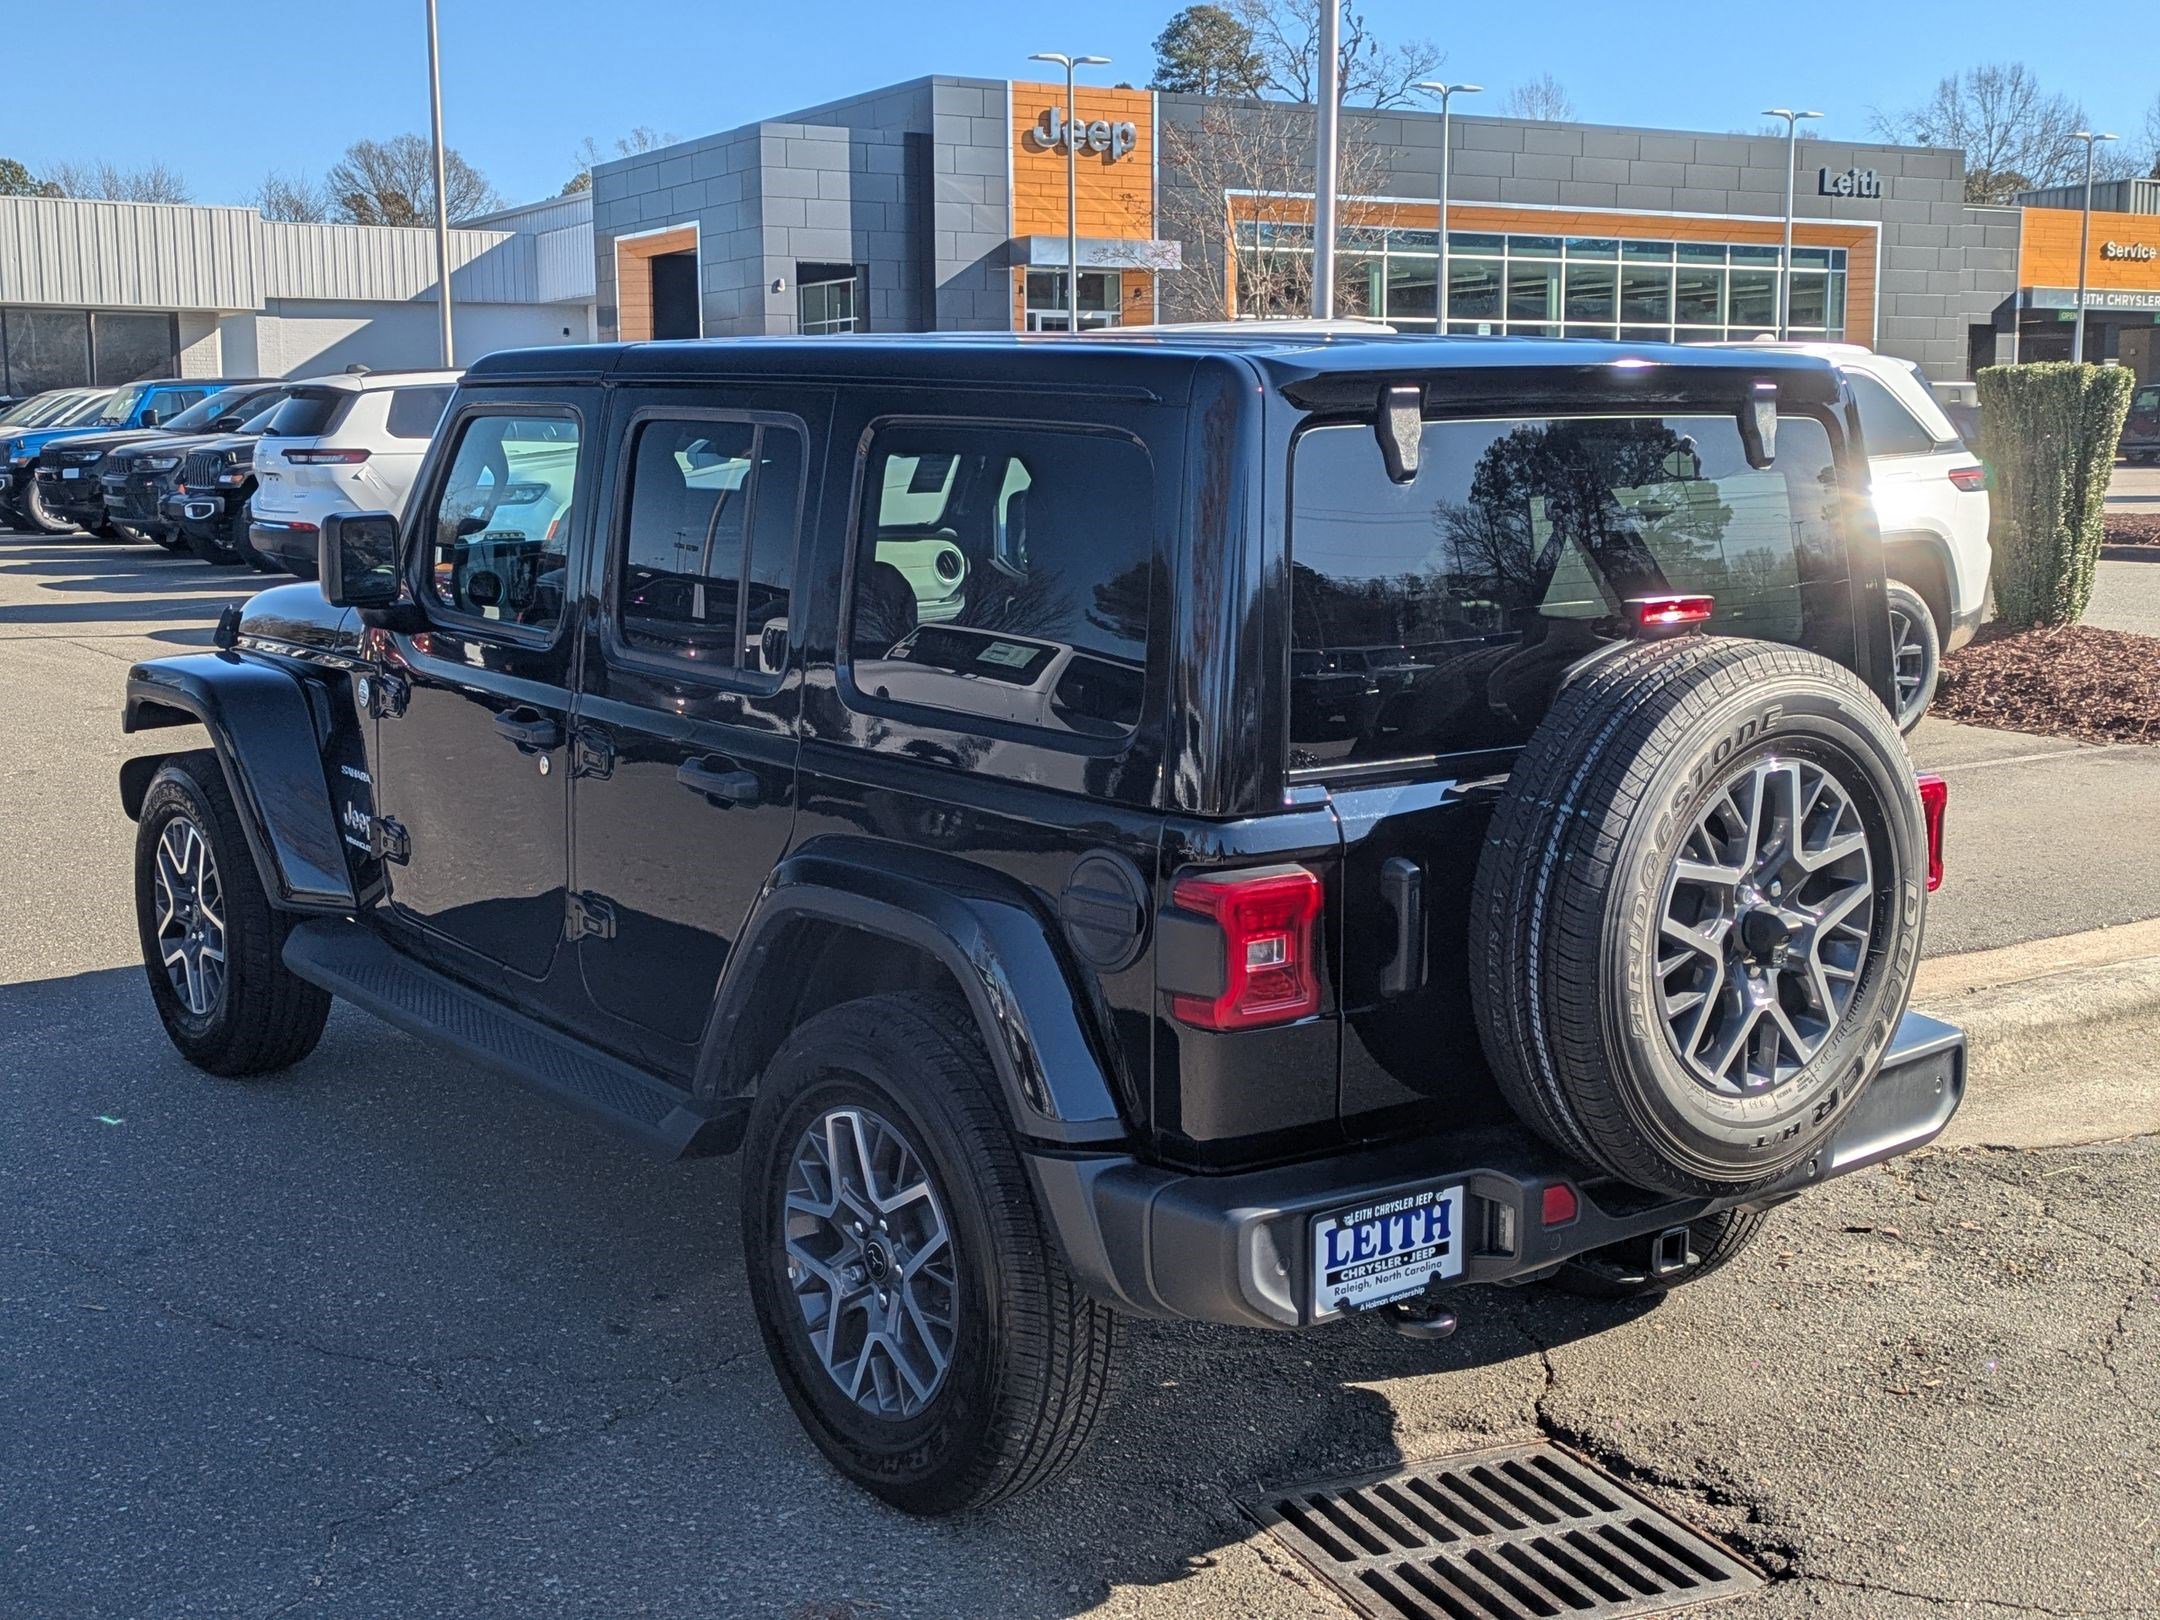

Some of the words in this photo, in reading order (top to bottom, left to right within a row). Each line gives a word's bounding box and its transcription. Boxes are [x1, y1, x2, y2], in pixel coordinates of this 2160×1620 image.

[1033, 106, 1137, 161] Jeep
[1822, 166, 1884, 197] Leith
[2106, 240, 2157, 259] Service
[2073, 293, 2104, 306] LEITH
[2107, 294, 2160, 308] CHRYSLER
[1624, 703, 1784, 1042] BRIDGESTONE
[1811, 878, 1921, 1128] DUELER
[1748, 1120, 1801, 1152] H/T
[1350, 1208, 1373, 1224] LEITH
[1374, 1197, 1415, 1218] CHRYSLER
[1415, 1191, 1434, 1206] JEEP
[1324, 1198, 1452, 1270] LEITH
[1334, 1279, 1372, 1297] Raleigh,
[1375, 1269, 1402, 1286] North
[1405, 1261, 1443, 1277] Carolina
[1340, 1256, 1402, 1281] CHRYSLER
[1409, 1246, 1437, 1263] JEEP
[1389, 1287, 1426, 1303] dealership
